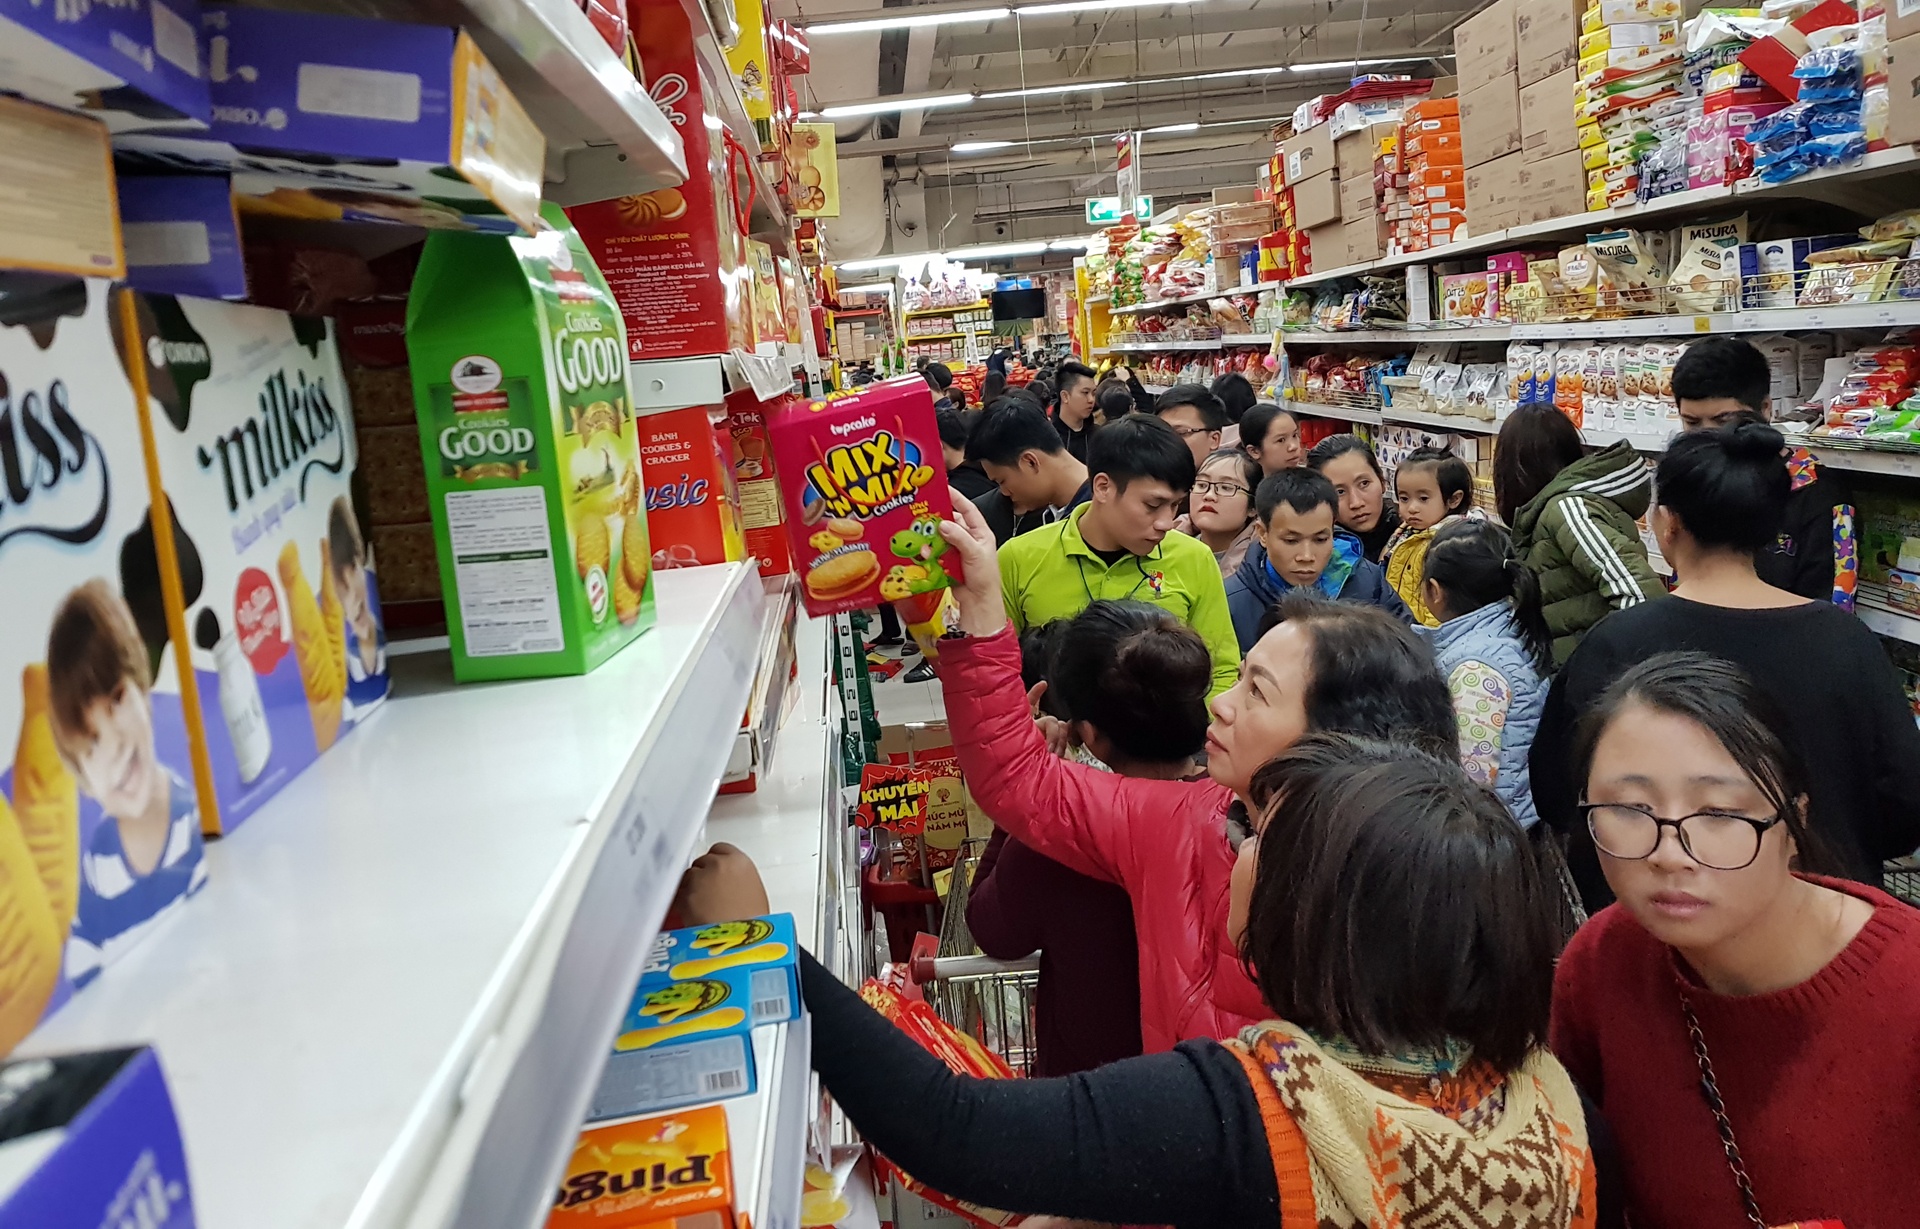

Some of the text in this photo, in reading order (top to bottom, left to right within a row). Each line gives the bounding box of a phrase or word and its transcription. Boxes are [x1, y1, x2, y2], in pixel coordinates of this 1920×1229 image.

[554, 328, 622, 393] GOOD
[651, 432, 678, 443] BÁNH
[830, 414, 876, 437] topcake
[197, 365, 344, 513] milkiss
[439, 427, 535, 460] GOOD
[641, 441, 691, 455] COOKIES &
[646, 453, 690, 466] CRACKER
[811, 433, 896, 498] MIX
[644, 473, 709, 512] usic
[849, 464, 915, 516] MIX
[873, 494, 914, 517] Cookies
[861, 778, 930, 804] KHUYẾN
[880, 799, 920, 822] MÃI
[925, 811, 946, 821] HÚC
